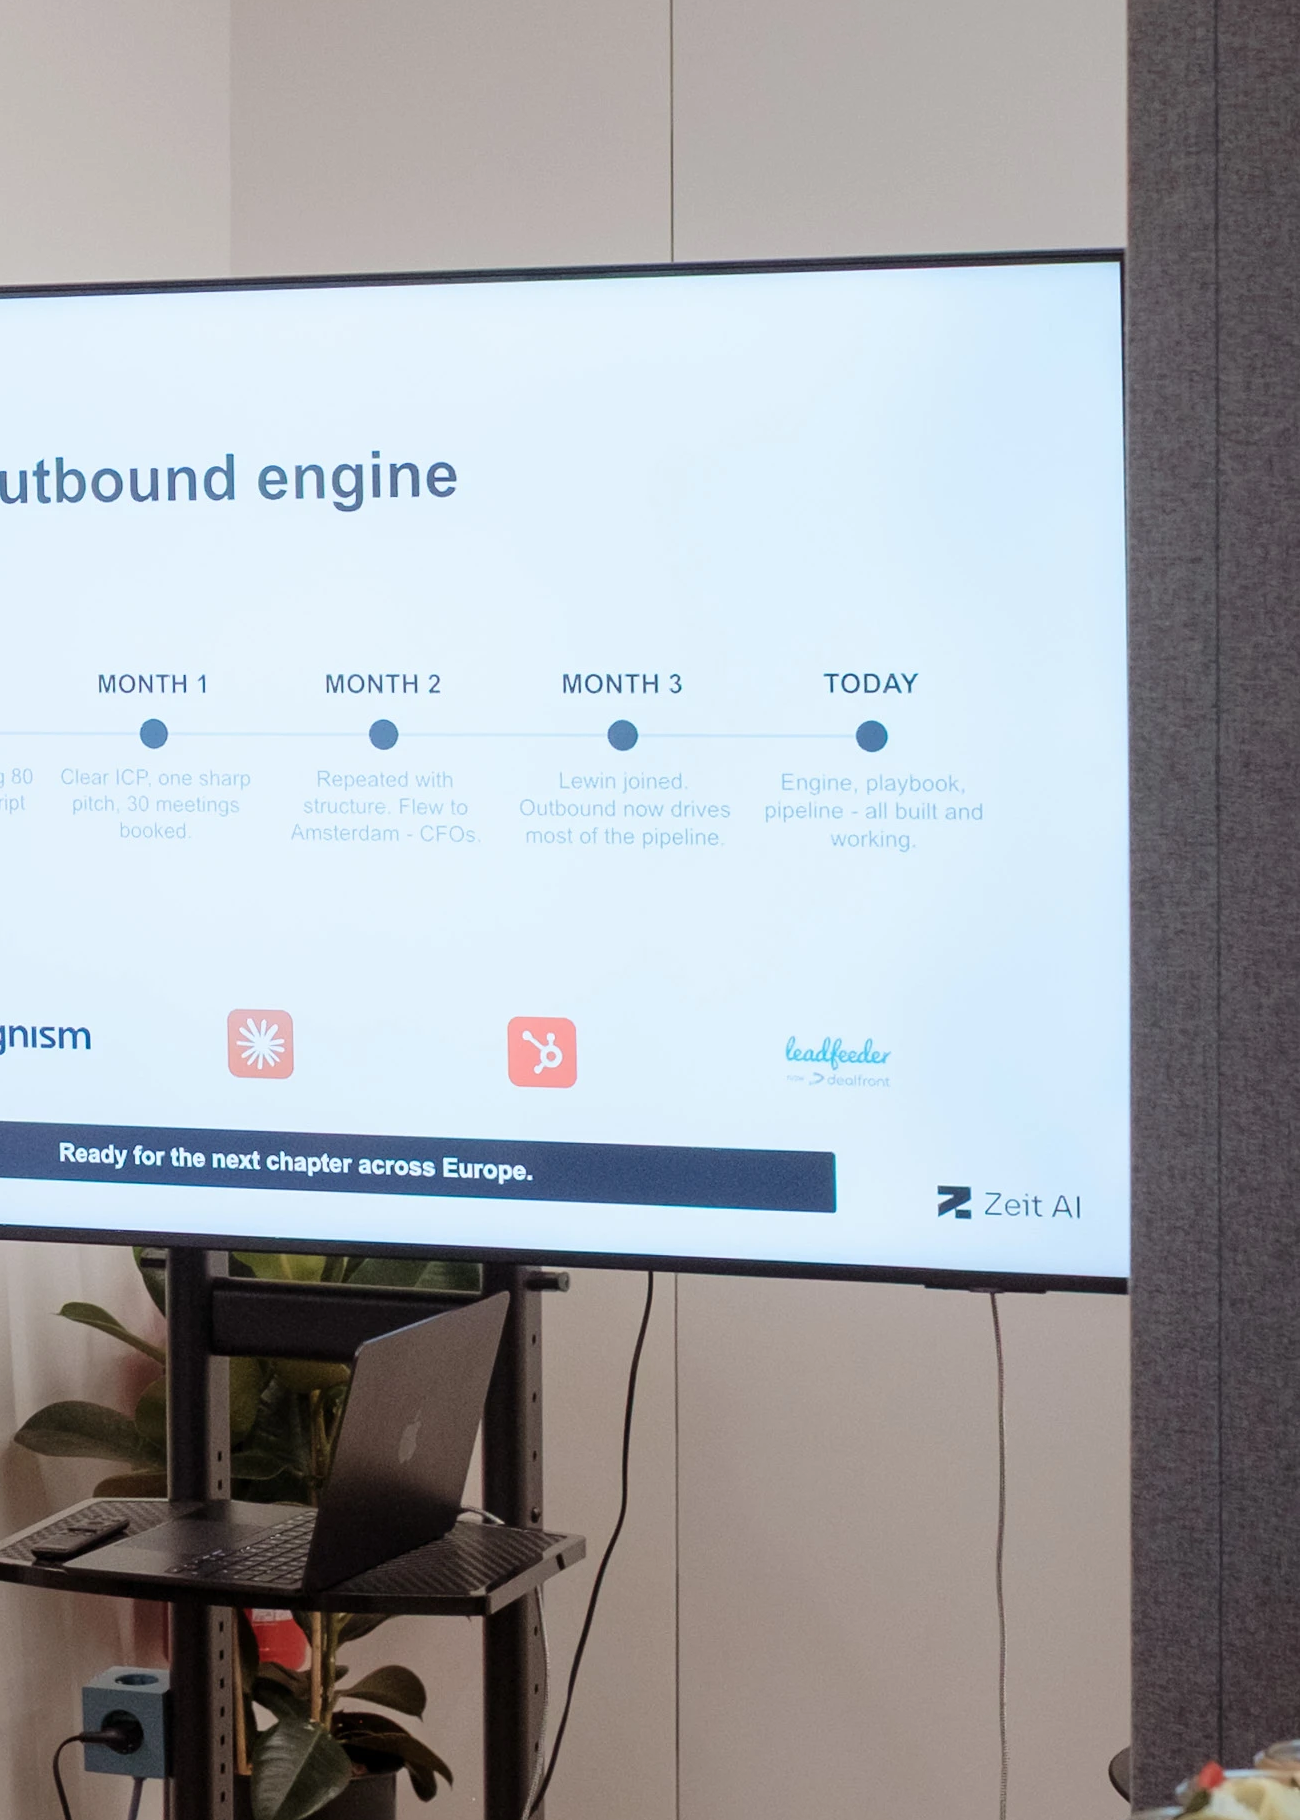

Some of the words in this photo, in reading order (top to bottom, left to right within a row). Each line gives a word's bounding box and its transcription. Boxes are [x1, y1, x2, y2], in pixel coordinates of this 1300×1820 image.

[258, 450, 457, 512] engine
[99, 674, 186, 693] MONTH
[198, 674, 205, 693] 1
[326, 674, 418, 694] MONTH
[429, 674, 440, 694] 2
[563, 674, 658, 694] MONTH
[669, 674, 682, 694] 3
[823, 673, 918, 693] TODAY
[11, 768, 33, 785] 80
[61, 768, 109, 786] Clear
[158, 773, 192, 786] one
[199, 770, 251, 790] sharp
[317, 770, 408, 791] Repeated
[415, 771, 453, 788] with
[560, 772, 616, 789] Lewin
[127, 795, 149, 812] 30
[156, 797, 239, 817] meetings
[399, 798, 444, 815] Flew
[451, 799, 468, 815] to
[520, 799, 616, 817] Outbound
[624, 804, 664, 817] now
[671, 800, 730, 818] drives
[765, 801, 843, 823] pipeline
[865, 802, 887, 819] all
[896, 802, 937, 820] built
[945, 803, 983, 820] and
[291, 823, 399, 841] Amsterdam
[526, 827, 573, 844] most
[580, 827, 599, 844] of
[604, 827, 635, 845] the
[785, 1036, 891, 1071] leadfeeder
[827, 1074, 891, 1087] dealfront
[60, 1143, 131, 1173] Ready
[133, 1145, 165, 1166] for
[170, 1147, 206, 1167] the
[212, 1151, 261, 1170] next
[266, 1151, 352, 1176] chapter
[358, 1159, 436, 1177] across
[443, 1158, 533, 1185] Europe.
[985, 1192, 1042, 1217] Zeit
[1052, 1195, 1080, 1219] AI
